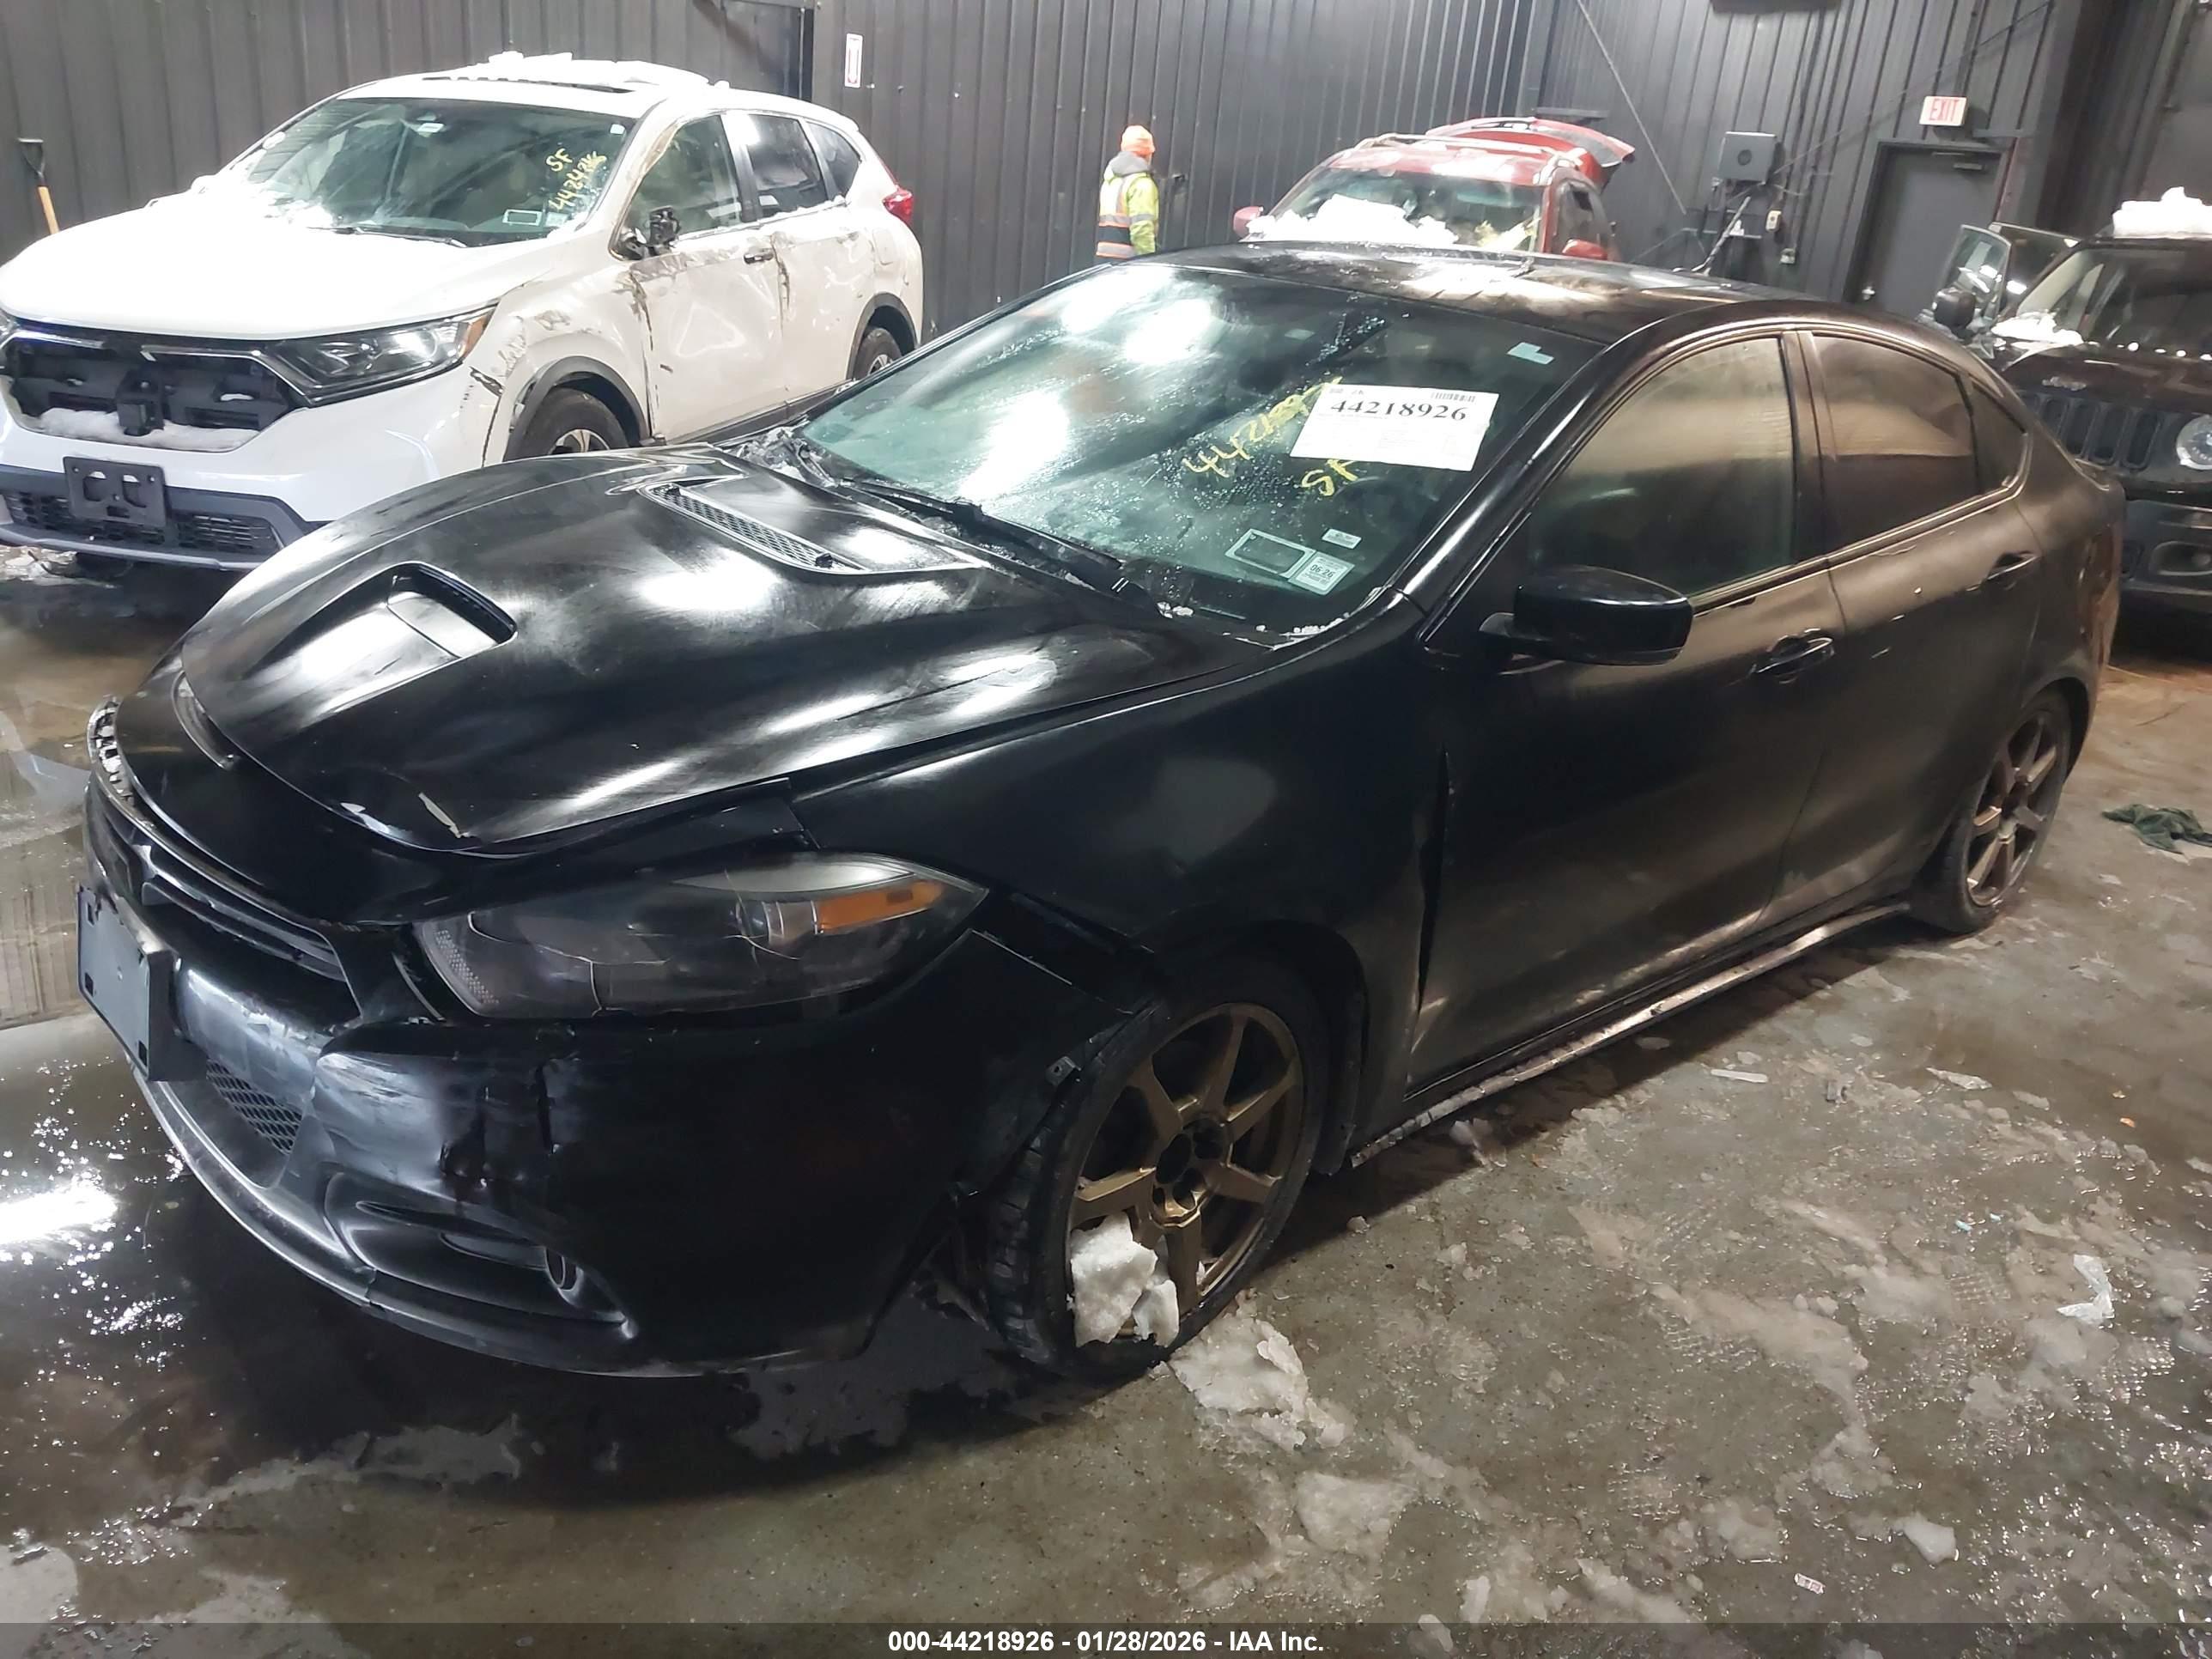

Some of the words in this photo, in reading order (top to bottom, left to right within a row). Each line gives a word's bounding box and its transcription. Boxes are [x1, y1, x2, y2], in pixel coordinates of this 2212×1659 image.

[1929, 97, 1960, 122] EXIT
[546, 148, 573, 172] SF
[1330, 400, 1469, 422] 44218926
